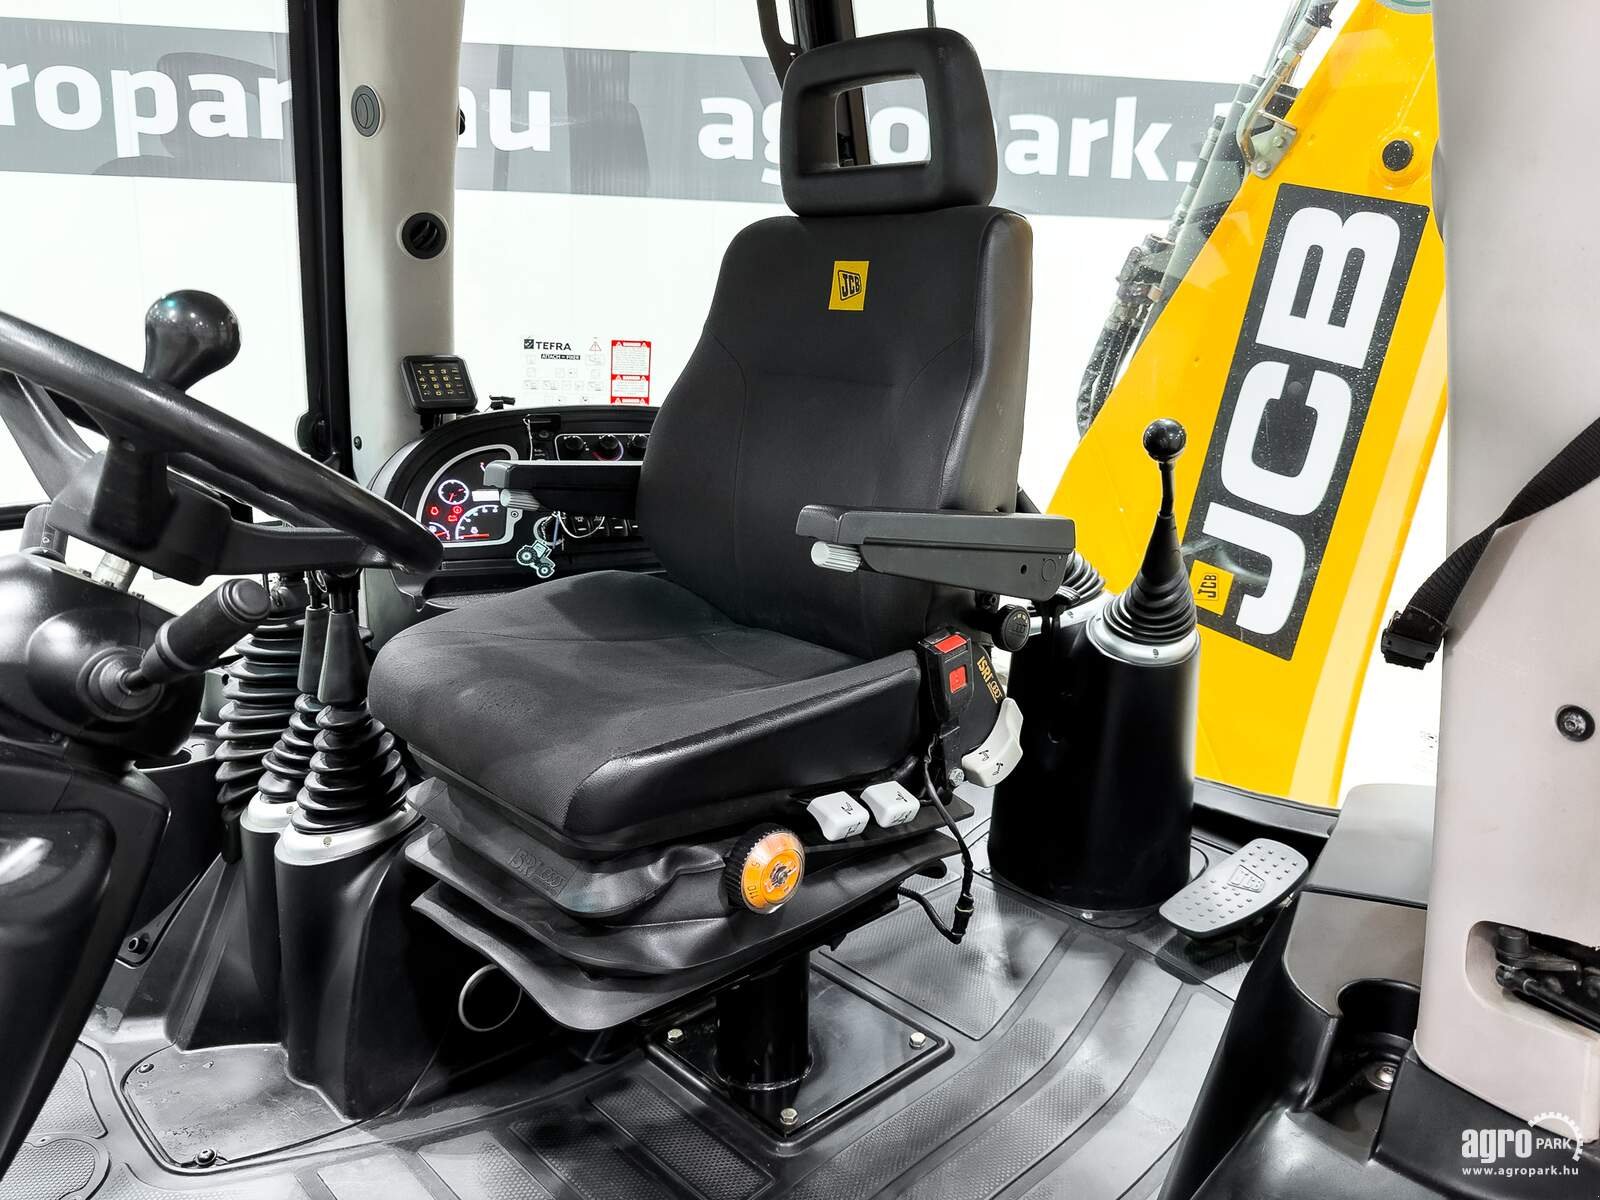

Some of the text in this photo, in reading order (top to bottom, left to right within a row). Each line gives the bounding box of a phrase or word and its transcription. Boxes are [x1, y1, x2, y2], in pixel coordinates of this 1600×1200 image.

[536, 341, 571, 350] TEFRA
[1202, 206, 1401, 636] JCB
[1197, 574, 1217, 598] JCB
[977, 656, 994, 683] ISRI
